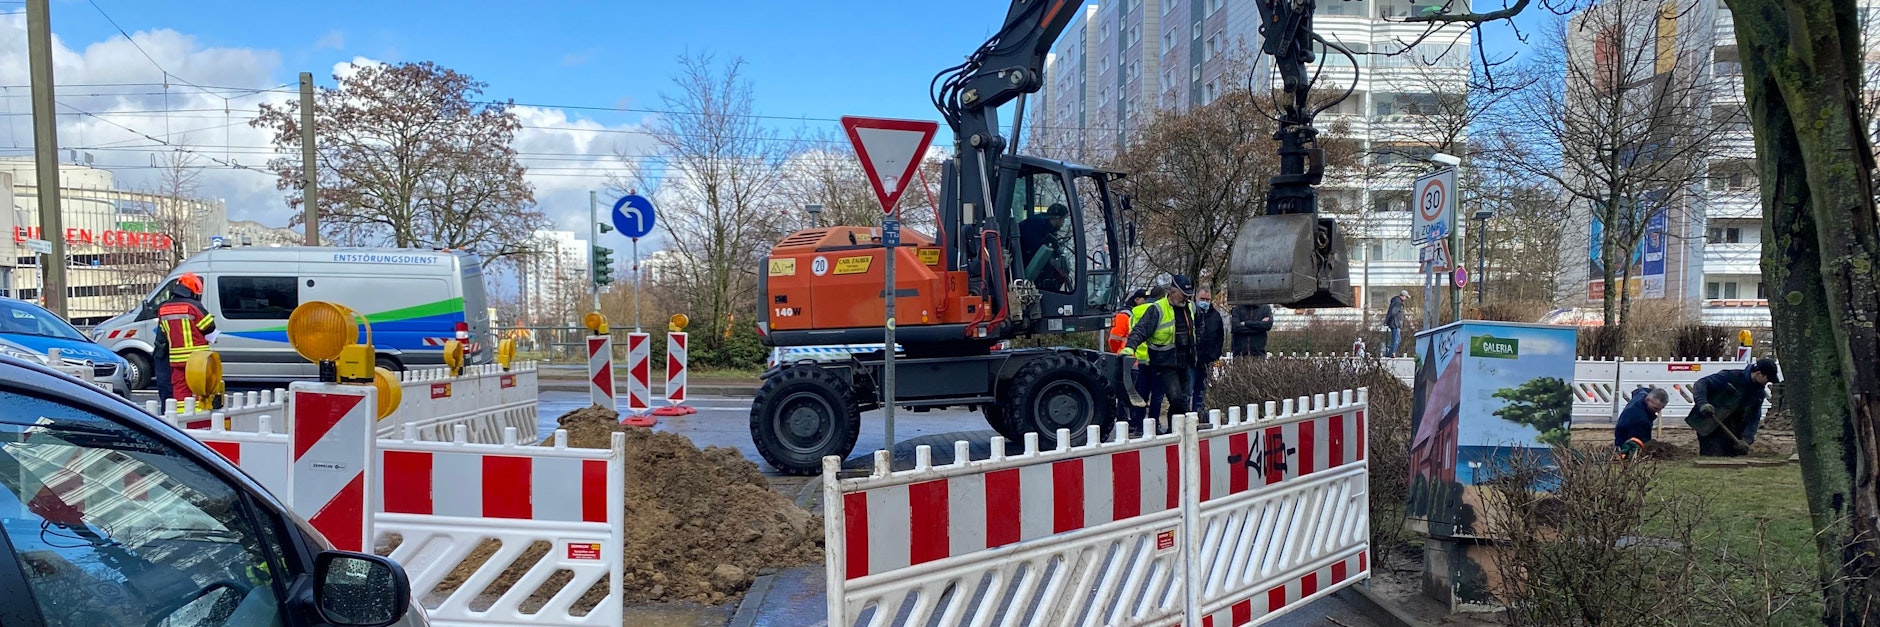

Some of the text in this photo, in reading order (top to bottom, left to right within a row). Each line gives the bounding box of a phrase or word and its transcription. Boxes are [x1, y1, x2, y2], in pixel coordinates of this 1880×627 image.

[1425, 190, 1440, 210] 30
[333, 253, 438, 264] ENTSTÖRUNGSDIENST
[815, 259, 825, 272] 20
[775, 307, 801, 317] 140W
[1482, 341, 1514, 354] GALERIA
